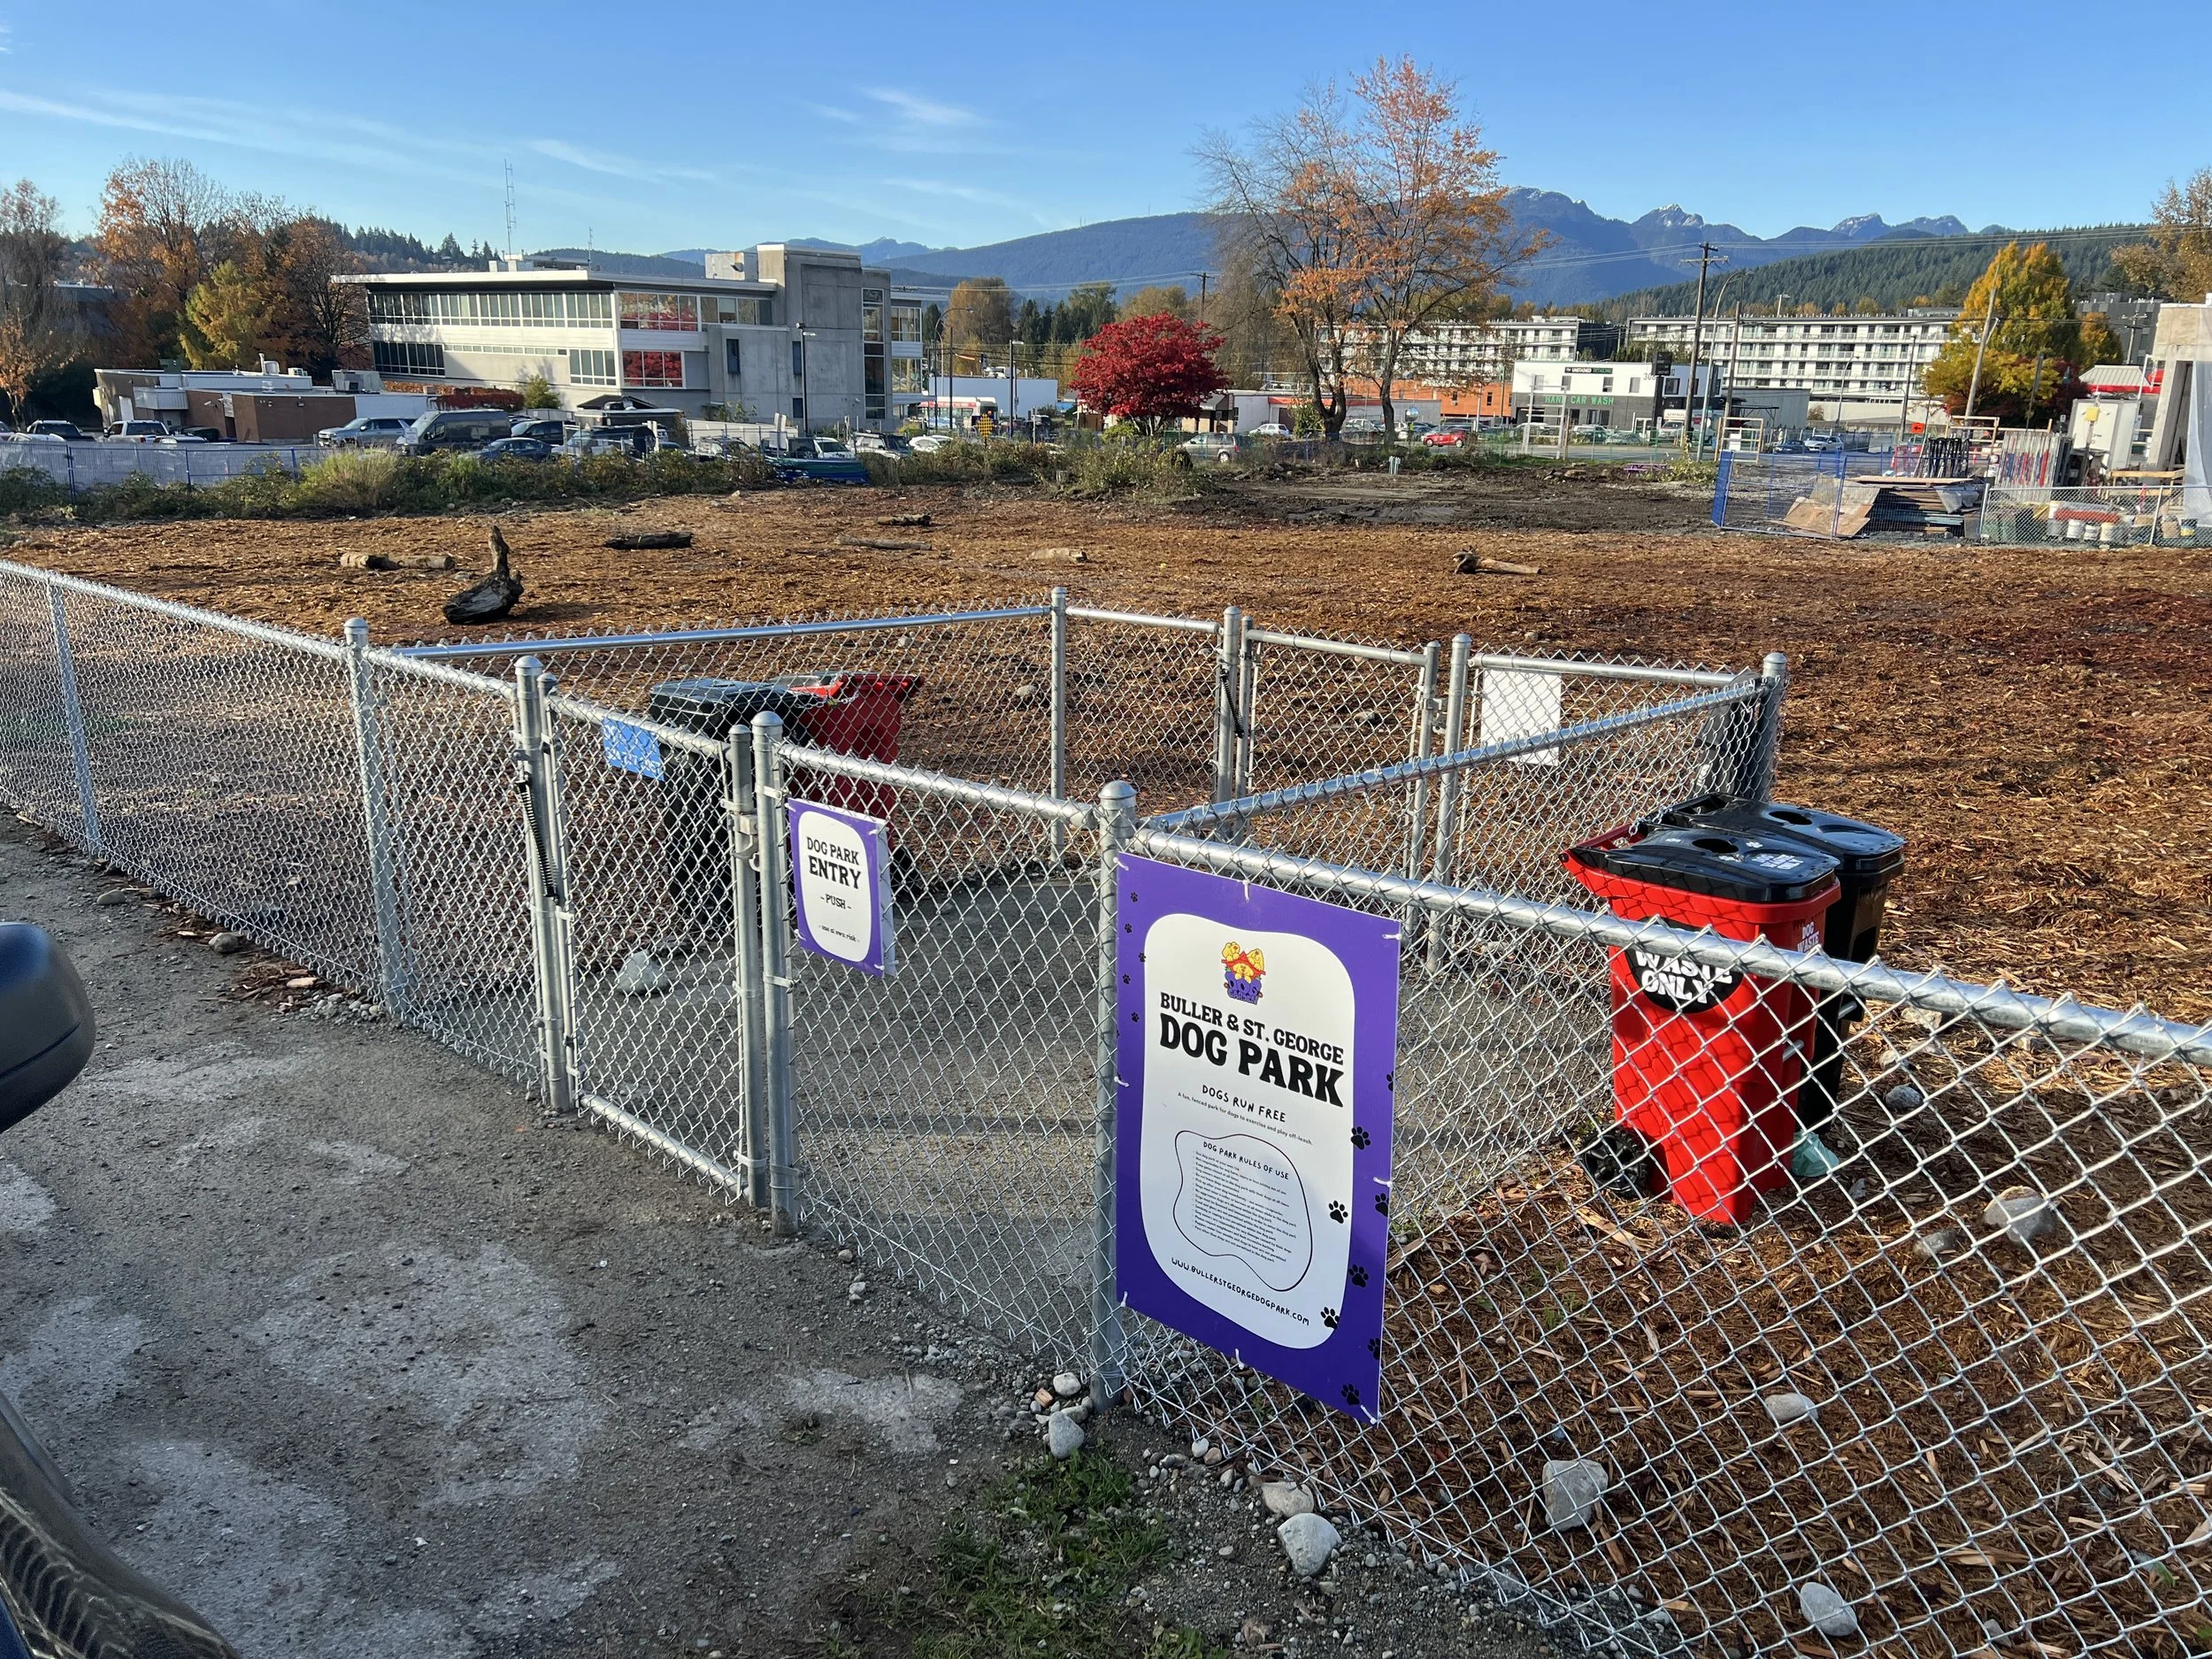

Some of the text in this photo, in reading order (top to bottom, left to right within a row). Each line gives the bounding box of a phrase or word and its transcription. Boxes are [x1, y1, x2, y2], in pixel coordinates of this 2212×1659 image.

[1571, 396, 1586, 404] CAR
[1591, 396, 1614, 405] WASH
[806, 836, 859, 865] DOG PARK
[809, 855, 861, 889] ENTRY
[1797, 931, 1819, 953] WASTE
[1802, 921, 1815, 940] DOG
[1635, 950, 1732, 984] WASTE
[1641, 970, 1715, 1003] ONLY
[1160, 992, 1344, 1065] BULLER & ST. GEORGE
[1160, 1012, 1344, 1108] DOG PARK
[1192, 1097, 1207, 1107] fenced
[1227, 1110, 1239, 1118] dogs
[1246, 1118, 1266, 1128] exercise
[1277, 1128, 1287, 1137] play
[1202, 1084, 1286, 1123] DOGS RUN FREE
[1203, 1141, 1289, 1179] DOG PARK RULES OF USE
